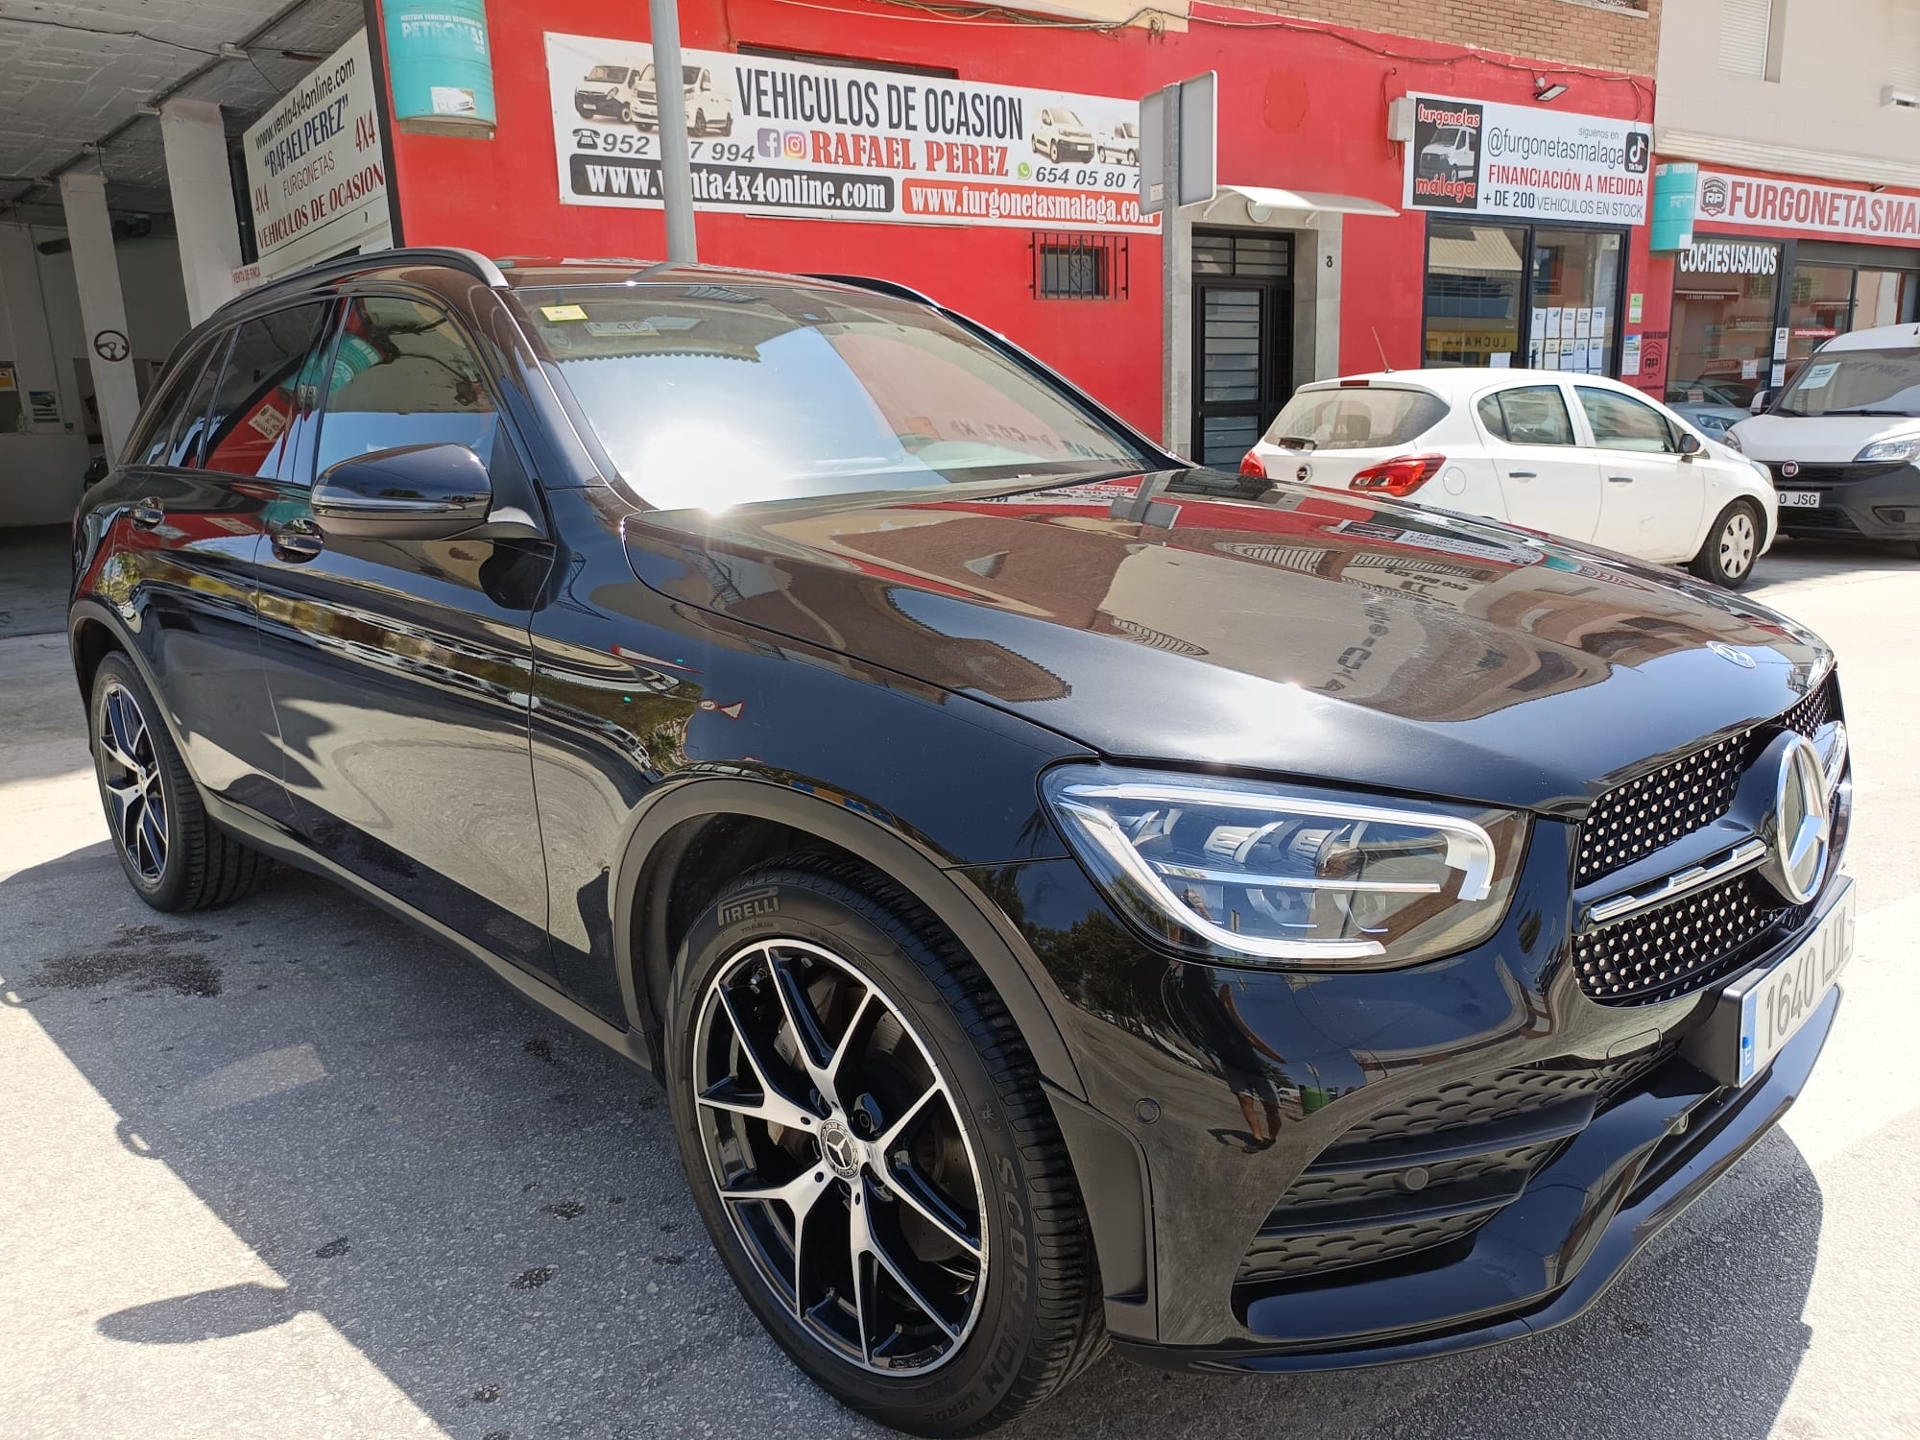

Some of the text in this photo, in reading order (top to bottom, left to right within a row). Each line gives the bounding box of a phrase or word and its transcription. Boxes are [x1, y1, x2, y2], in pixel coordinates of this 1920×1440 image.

[735, 66, 1023, 140] VEHICULOS DE OCASION
[1418, 104, 1480, 128] furgonetas
[602, 133, 650, 155] 952
[712, 143, 755, 162] 994
[810, 130, 1009, 176] RAFAEL PEREZ
[1488, 127, 1625, 169] @furgonetasmalaga
[283, 150, 335, 199] FURGONETAS
[585, 164, 887, 209] www.nta4x4online.com
[1036, 166, 1140, 189] 654 05 80 7
[1415, 173, 1476, 203] málaga
[1488, 164, 1644, 197] FINANCIACIÓN A MEDIDA
[258, 161, 385, 249] VEHICULOS DE OCASION
[1494, 190, 1509, 207] DE
[1513, 193, 1535, 208] 200
[1536, 196, 1593, 214] VEHICULOS
[1596, 201, 1609, 215] EN
[1611, 203, 1643, 218] STOCK
[1729, 181, 1920, 234] FURGONETASMA
[1326, 256, 1333, 268] 3
[1680, 243, 1777, 275] COCHESUSADOS
[1793, 494, 1817, 506] JSG
[718, 886, 779, 926] PIRELLI
[1766, 947, 1815, 1050] 1640
